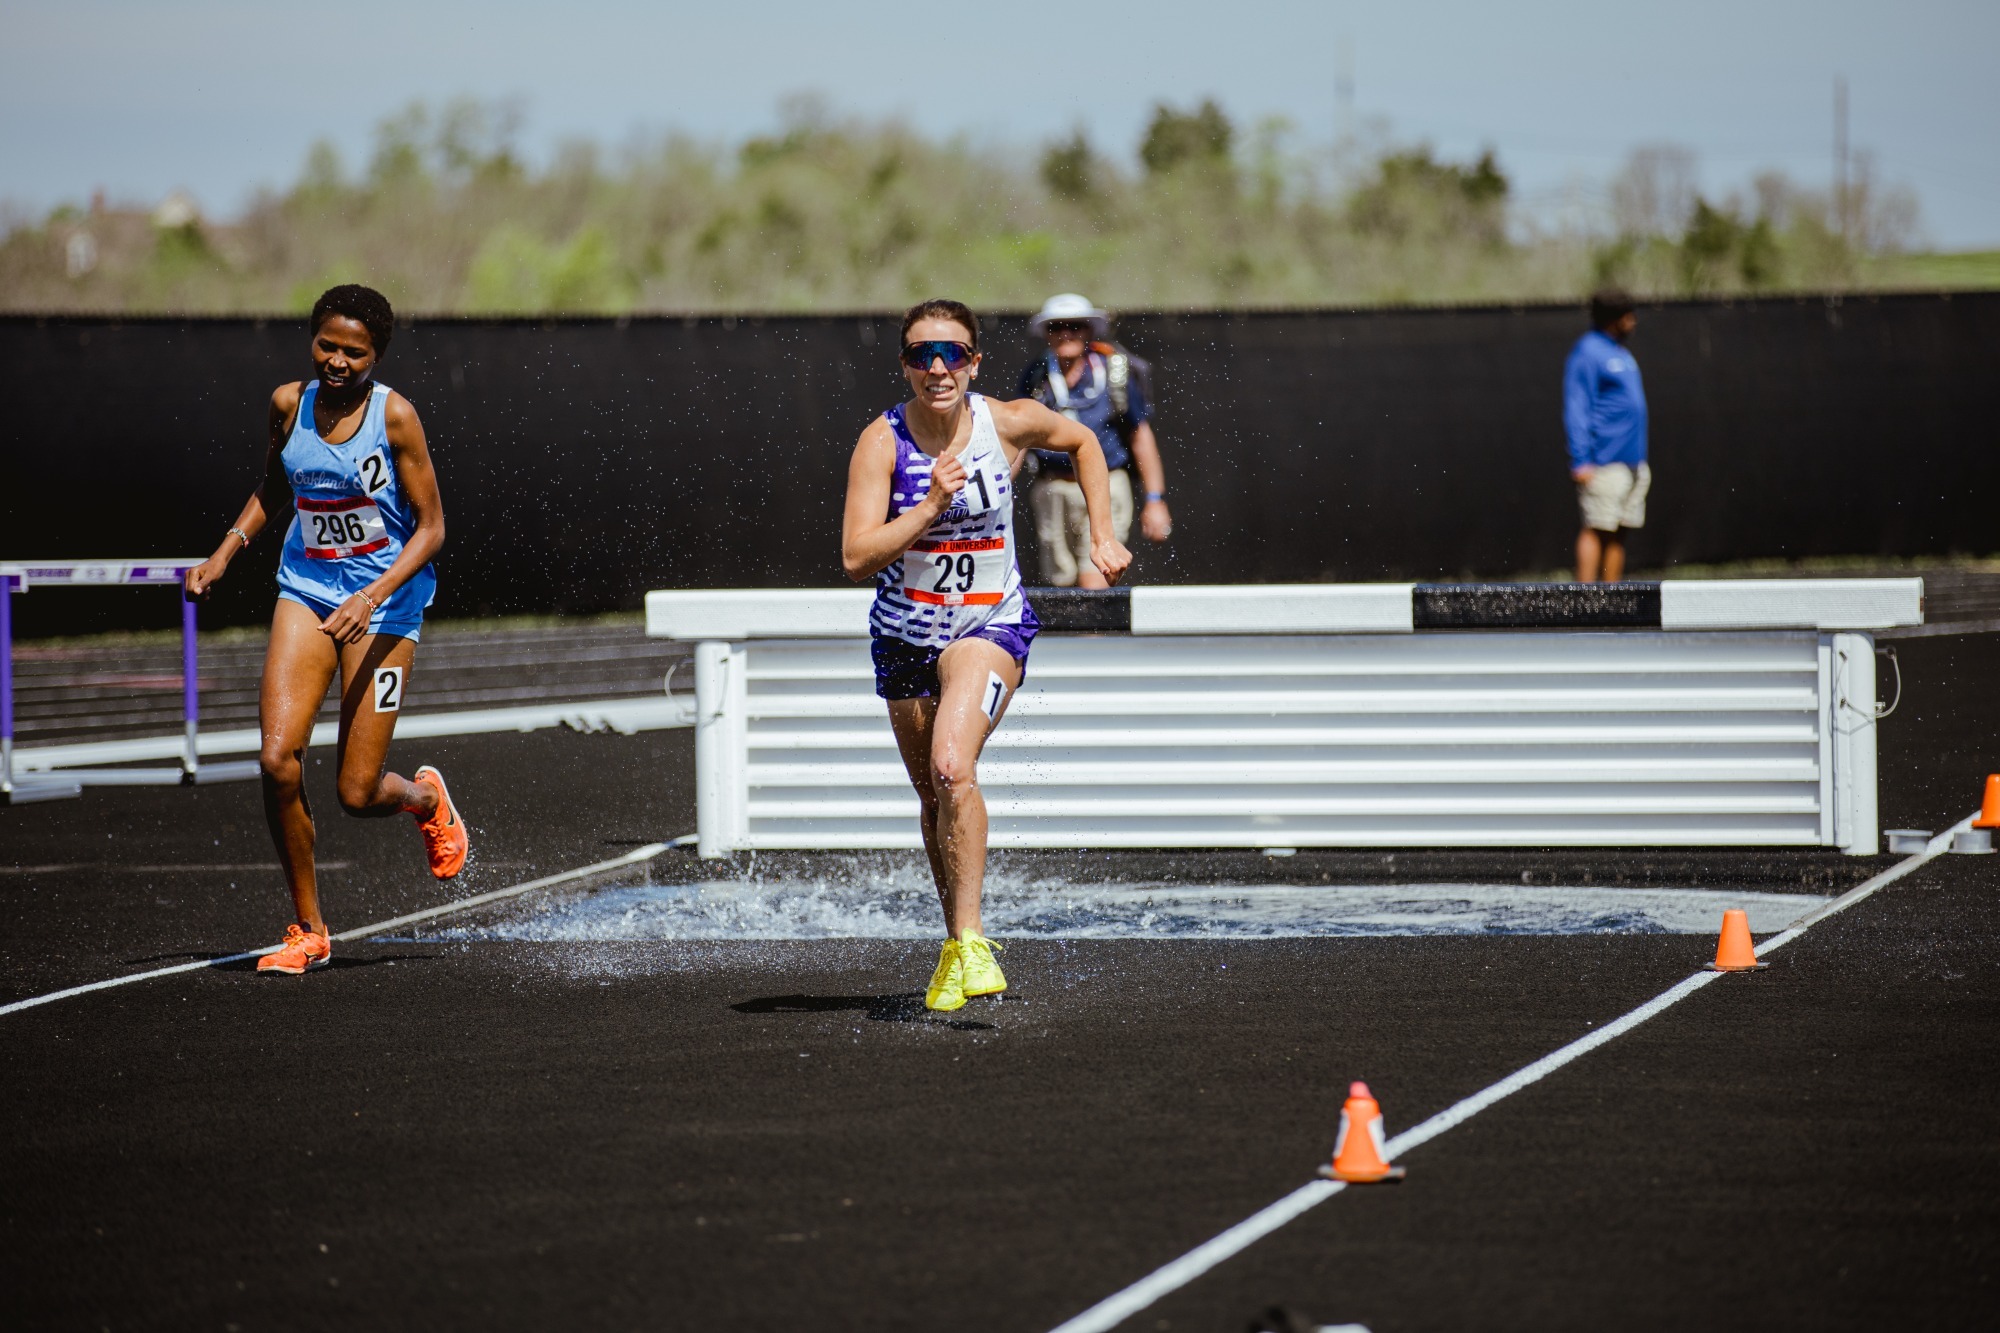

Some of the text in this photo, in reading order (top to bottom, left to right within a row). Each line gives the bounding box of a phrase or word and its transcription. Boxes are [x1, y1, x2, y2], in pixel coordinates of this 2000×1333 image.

[293, 468, 349, 490] Oakland
[362, 455, 387, 493] 2
[968, 469, 991, 509] 1
[313, 513, 365, 545] 296
[950, 540, 996, 551] UNIVERSITY
[933, 553, 975, 593] 29
[379, 671, 397, 709] 2
[989, 681, 1002, 718] 1
